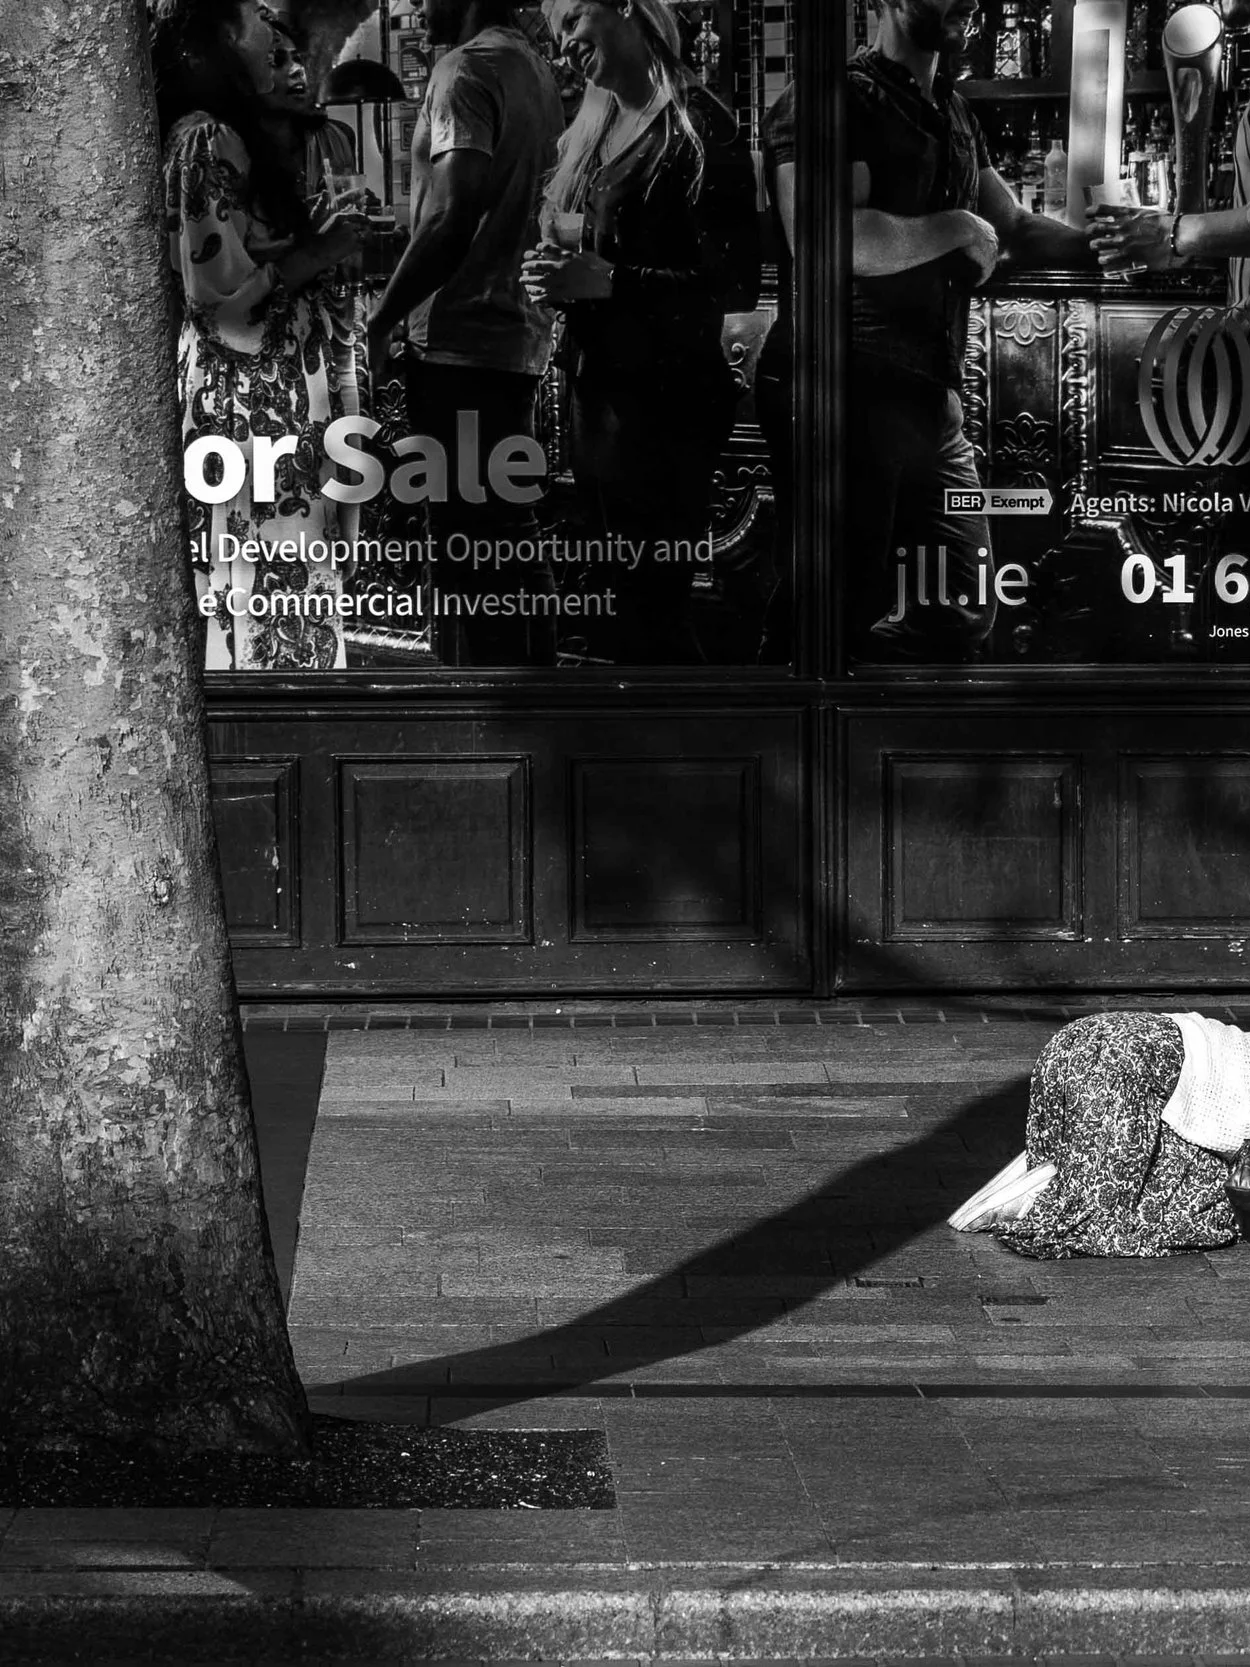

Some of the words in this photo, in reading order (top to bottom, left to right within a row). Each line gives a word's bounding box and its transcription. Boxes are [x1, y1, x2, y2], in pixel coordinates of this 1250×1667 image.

[320, 410, 548, 504] Sale
[951, 495, 981, 508] BER
[991, 495, 1045, 511] Exempt
[1070, 492, 1156, 518] Agents:
[1163, 491, 1233, 513] Nicola
[218, 531, 437, 570] Development
[446, 532, 645, 570] Opportunity
[653, 531, 714, 563] and
[889, 545, 1030, 622] jll.ie
[1121, 553, 1194, 605] 01
[226, 587, 422, 617] Commercial
[433, 587, 616, 617] Investment
[1208, 624, 1249, 638] Jones
